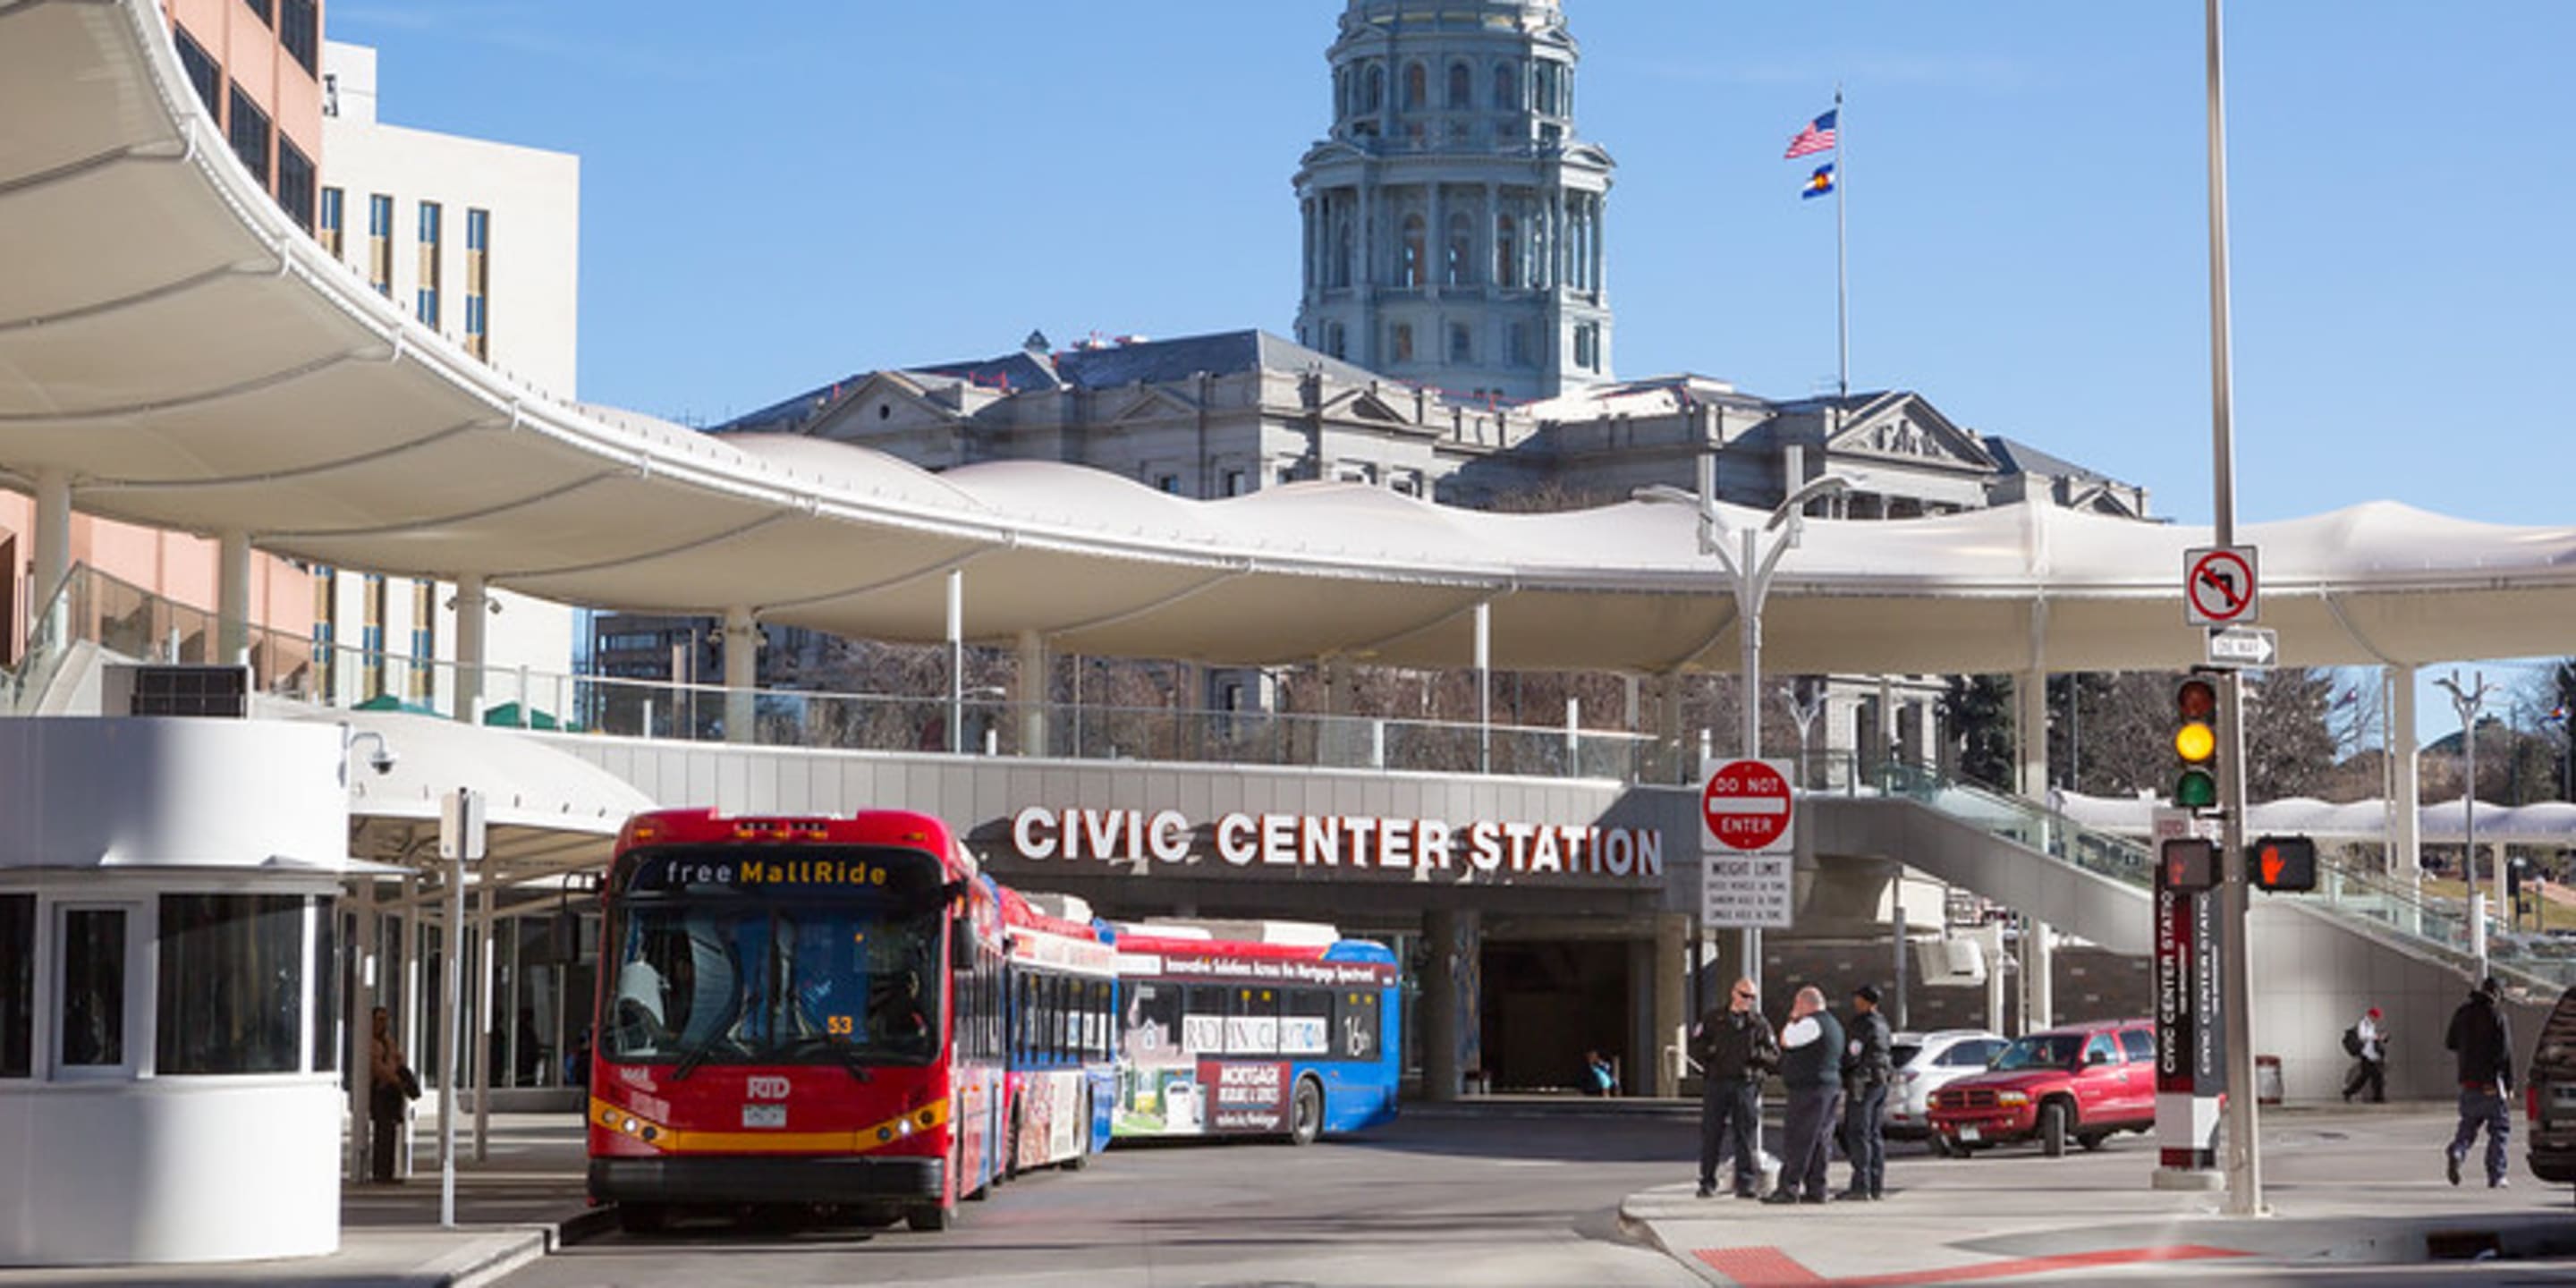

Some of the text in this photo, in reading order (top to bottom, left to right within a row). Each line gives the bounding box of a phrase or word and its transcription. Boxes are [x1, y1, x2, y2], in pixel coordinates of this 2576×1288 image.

[1716, 776, 1778, 792] DO NOT
[1722, 818, 1772, 834] ENTER
[1013, 806, 1663, 876] CIVIC CENTER STATION
[667, 860, 887, 885] free MallRide
[2161, 892, 2176, 1073] CIVIC CENTER STATIO
[2199, 893, 2211, 1076] CIVIC CENTER STATIO
[827, 1015, 853, 1034] 53
[747, 1076, 791, 1099] RTD
